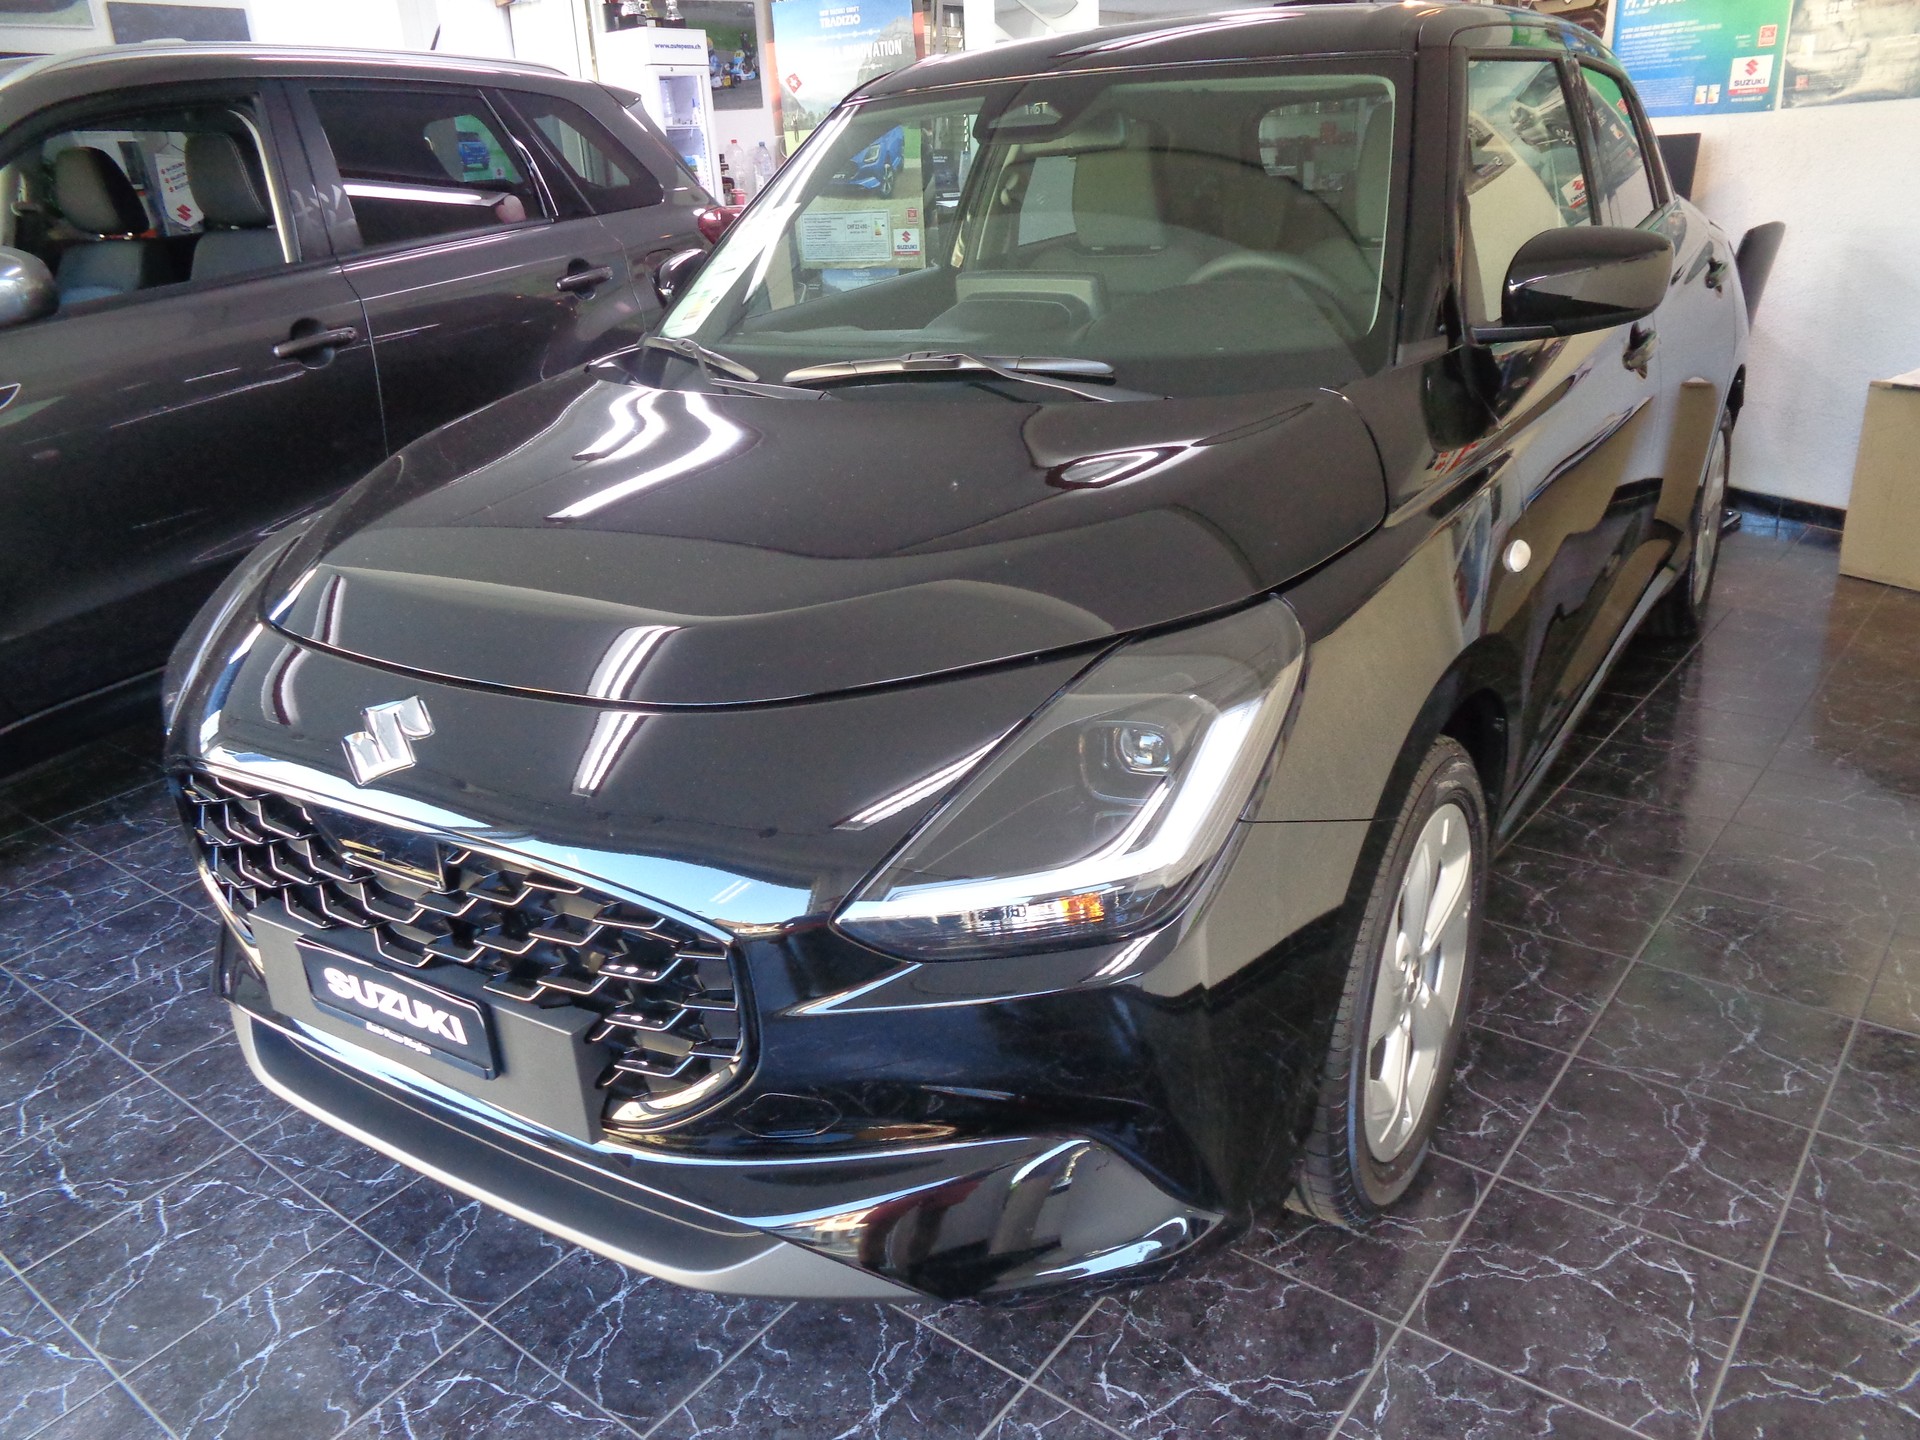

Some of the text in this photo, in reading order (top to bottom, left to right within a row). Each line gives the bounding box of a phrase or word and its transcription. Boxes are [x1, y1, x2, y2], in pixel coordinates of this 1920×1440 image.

[819, 14, 861, 29] TRADIZIO
[1734, 78, 1766, 86] SUZUKI
[323, 967, 468, 1046] SUZUKI
